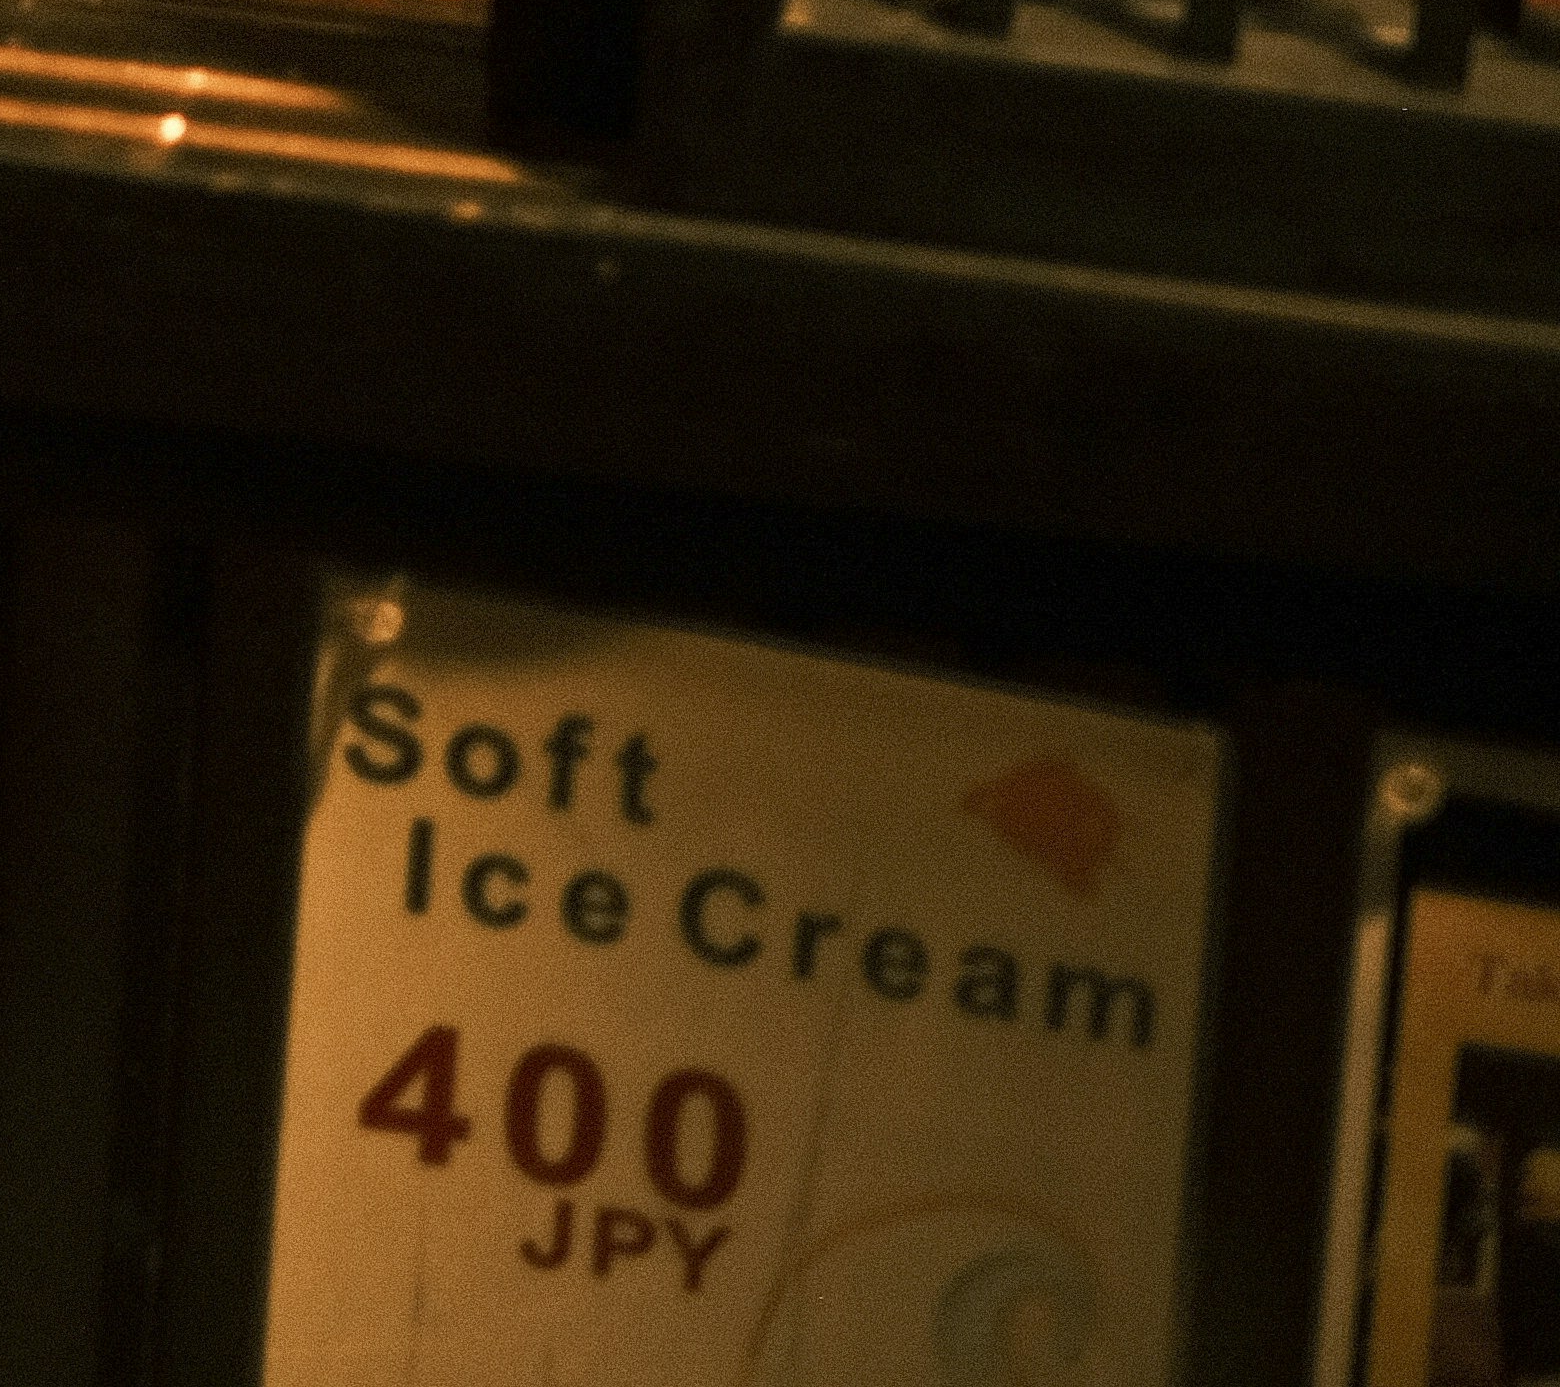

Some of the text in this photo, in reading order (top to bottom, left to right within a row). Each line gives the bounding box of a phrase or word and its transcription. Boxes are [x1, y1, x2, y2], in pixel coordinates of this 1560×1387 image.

[342, 682, 665, 827] Soft
[402, 813, 1159, 1050] Ice Cream
[356, 1020, 752, 1212] 400
[519, 1198, 732, 1296] JPY
